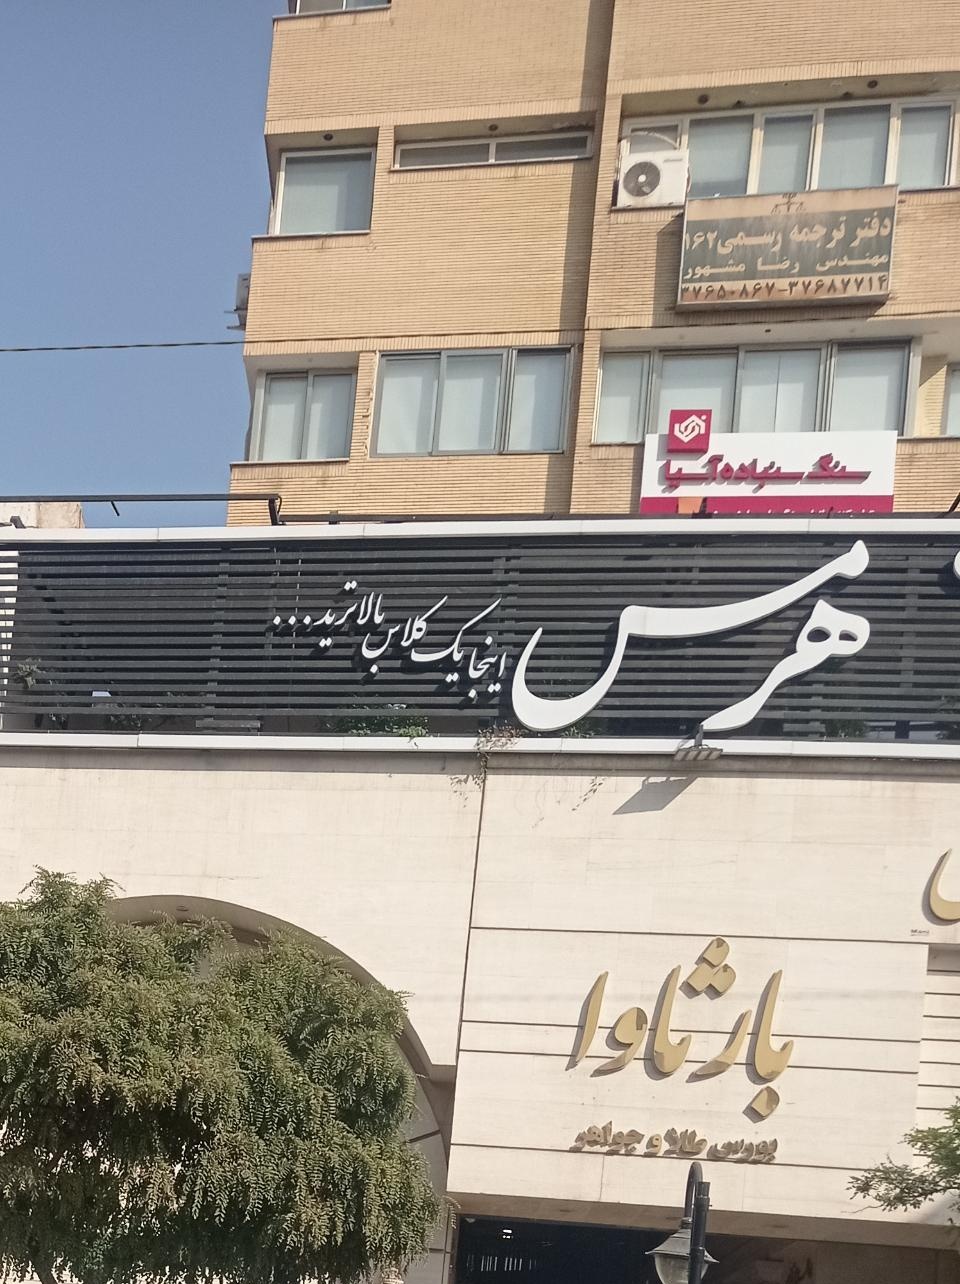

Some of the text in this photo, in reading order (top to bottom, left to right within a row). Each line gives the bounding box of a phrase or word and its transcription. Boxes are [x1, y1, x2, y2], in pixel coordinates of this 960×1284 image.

[716, 229, 783, 255] رسمی
[789, 215, 847, 249] ترجمه
[849, 211, 891, 248] دفتر
[683, 252, 889, 280] مهندس رضا مشهور
[663, 455, 724, 490] آسیا
[804, 453, 872, 483] سنگ
[360, 594, 449, 660] کلاس
[410, 597, 502, 684] یک
[511, 539, 870, 732] هرمس
[467, 634, 507, 702] اینجا
[644, 1133, 663, 1157] و
[664, 1127, 708, 1158] طلا
[706, 1138, 778, 1164] بورس
